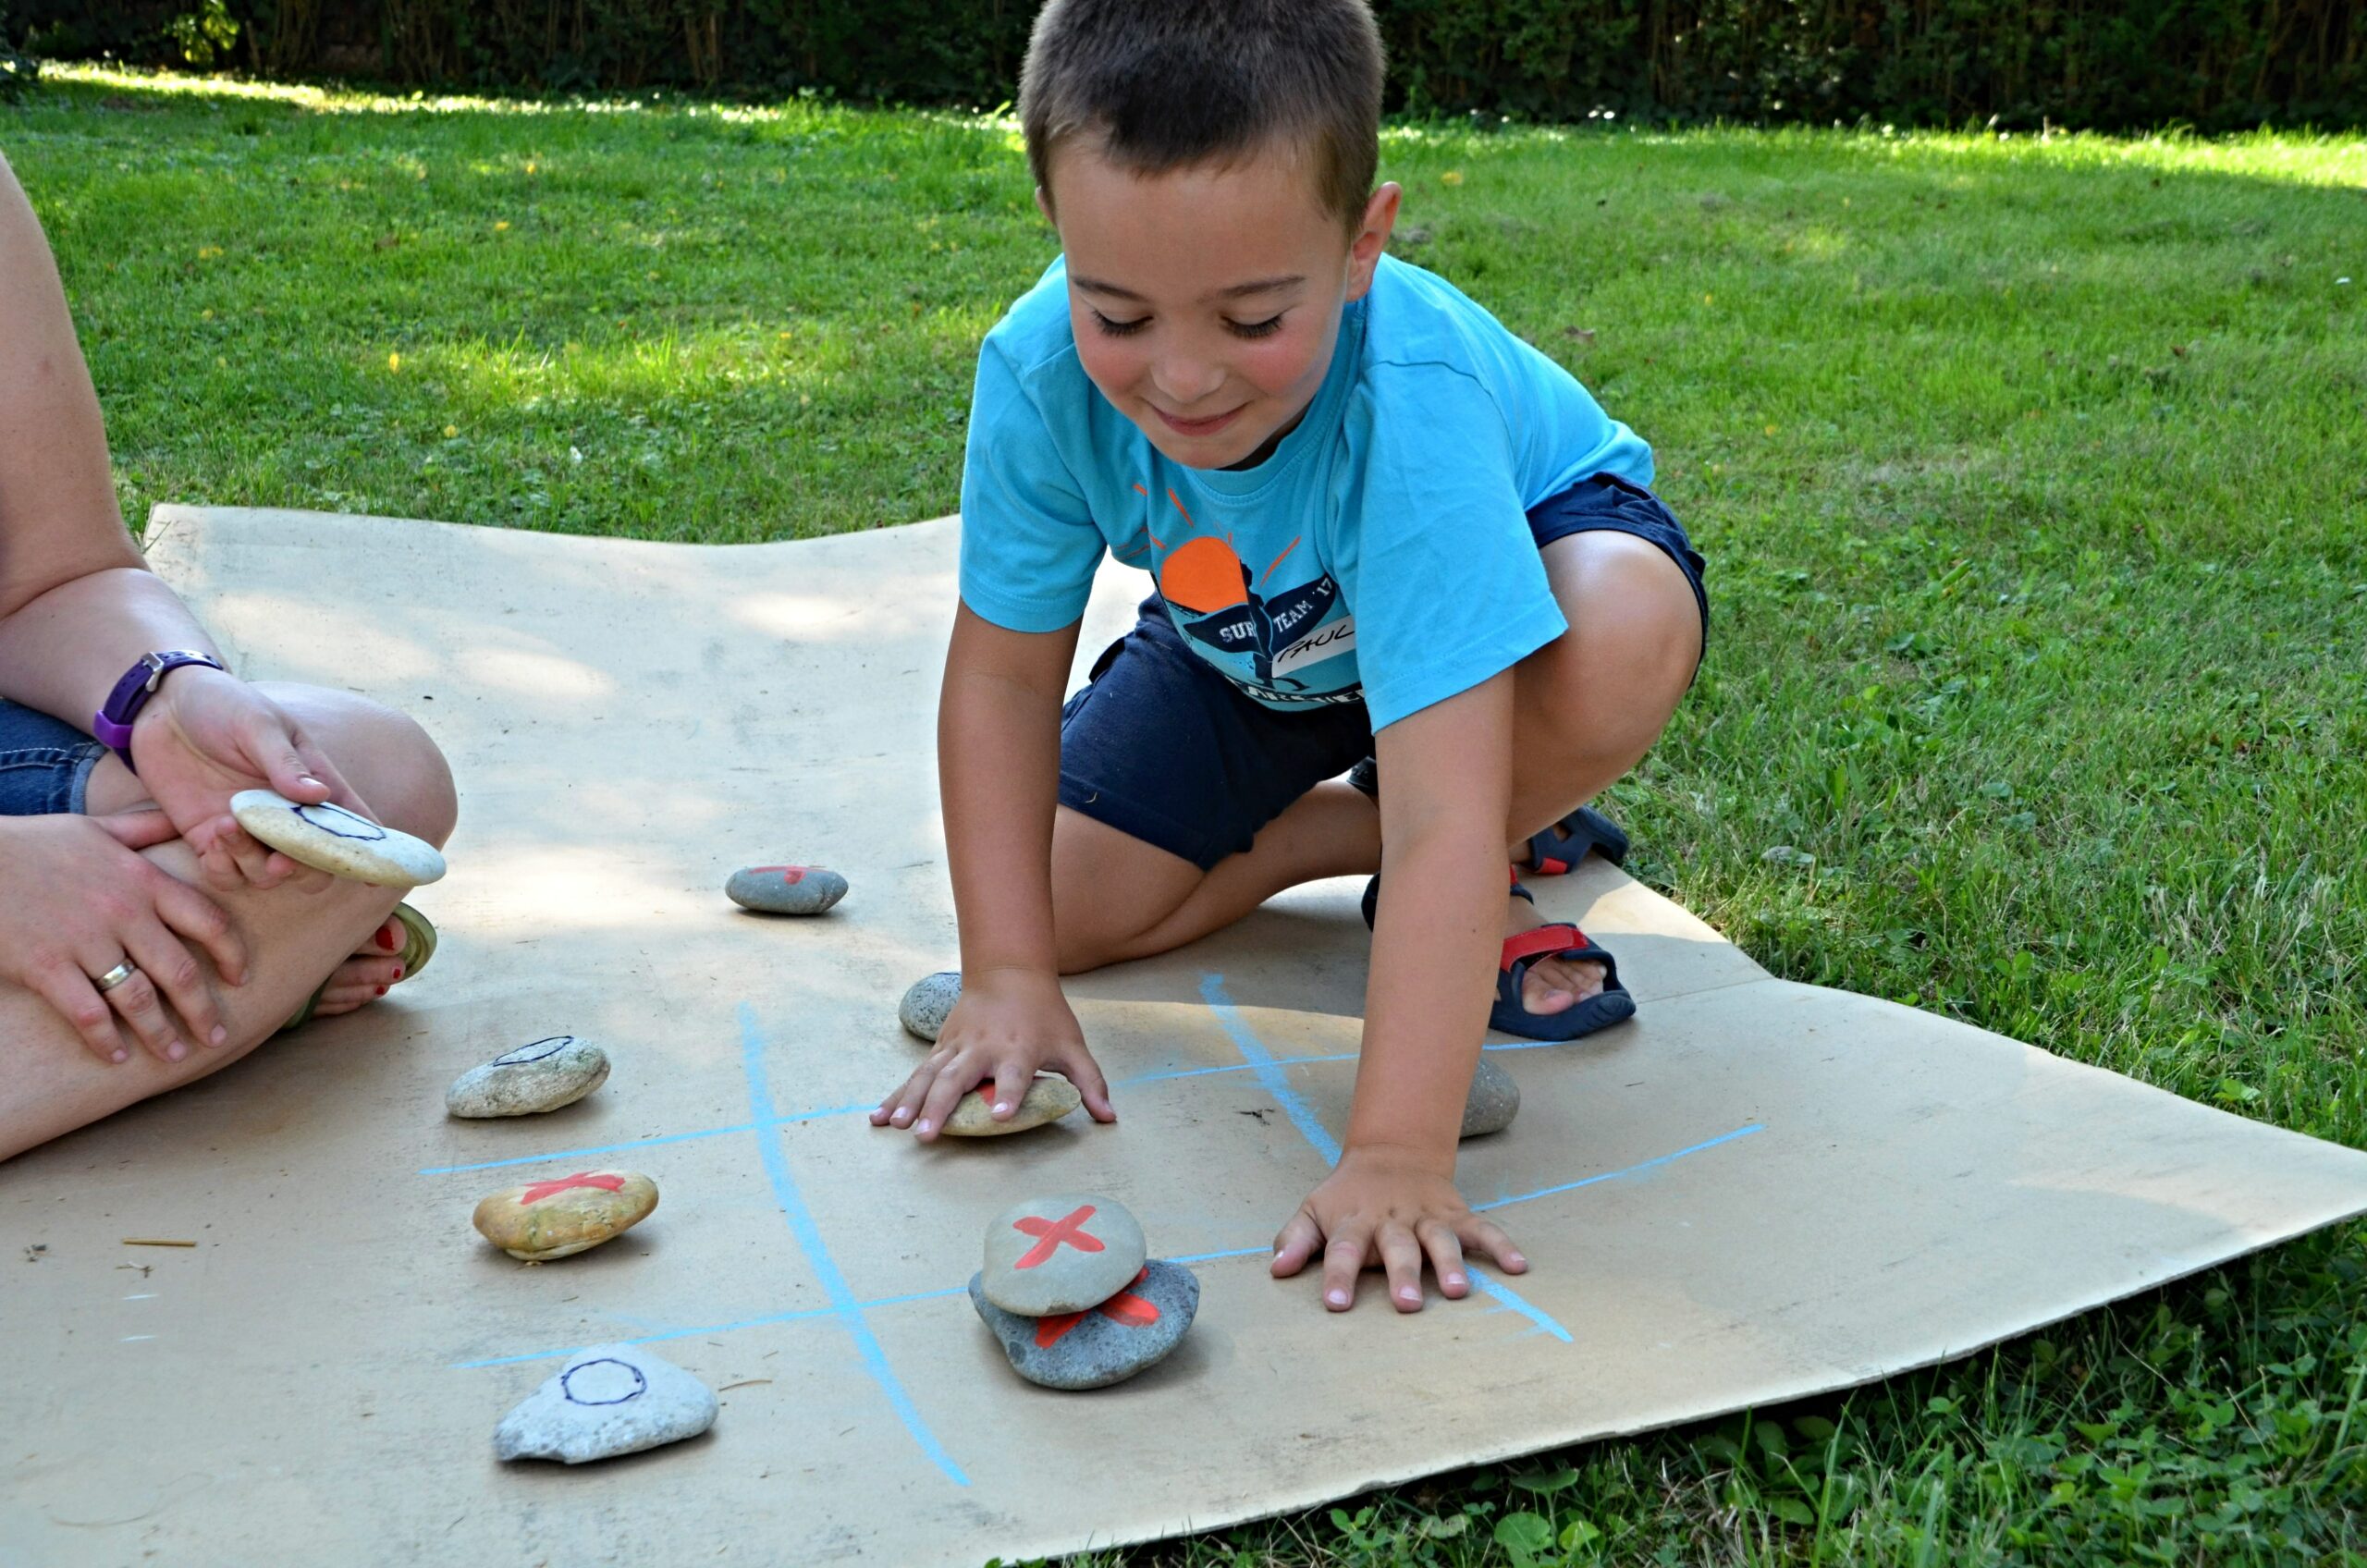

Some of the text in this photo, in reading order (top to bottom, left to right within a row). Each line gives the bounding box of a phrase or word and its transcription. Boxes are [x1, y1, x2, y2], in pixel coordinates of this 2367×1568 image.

[1219, 620, 1257, 643] SUR
[1273, 600, 1313, 632] TEAM
[1278, 625, 1355, 663] PAUL
